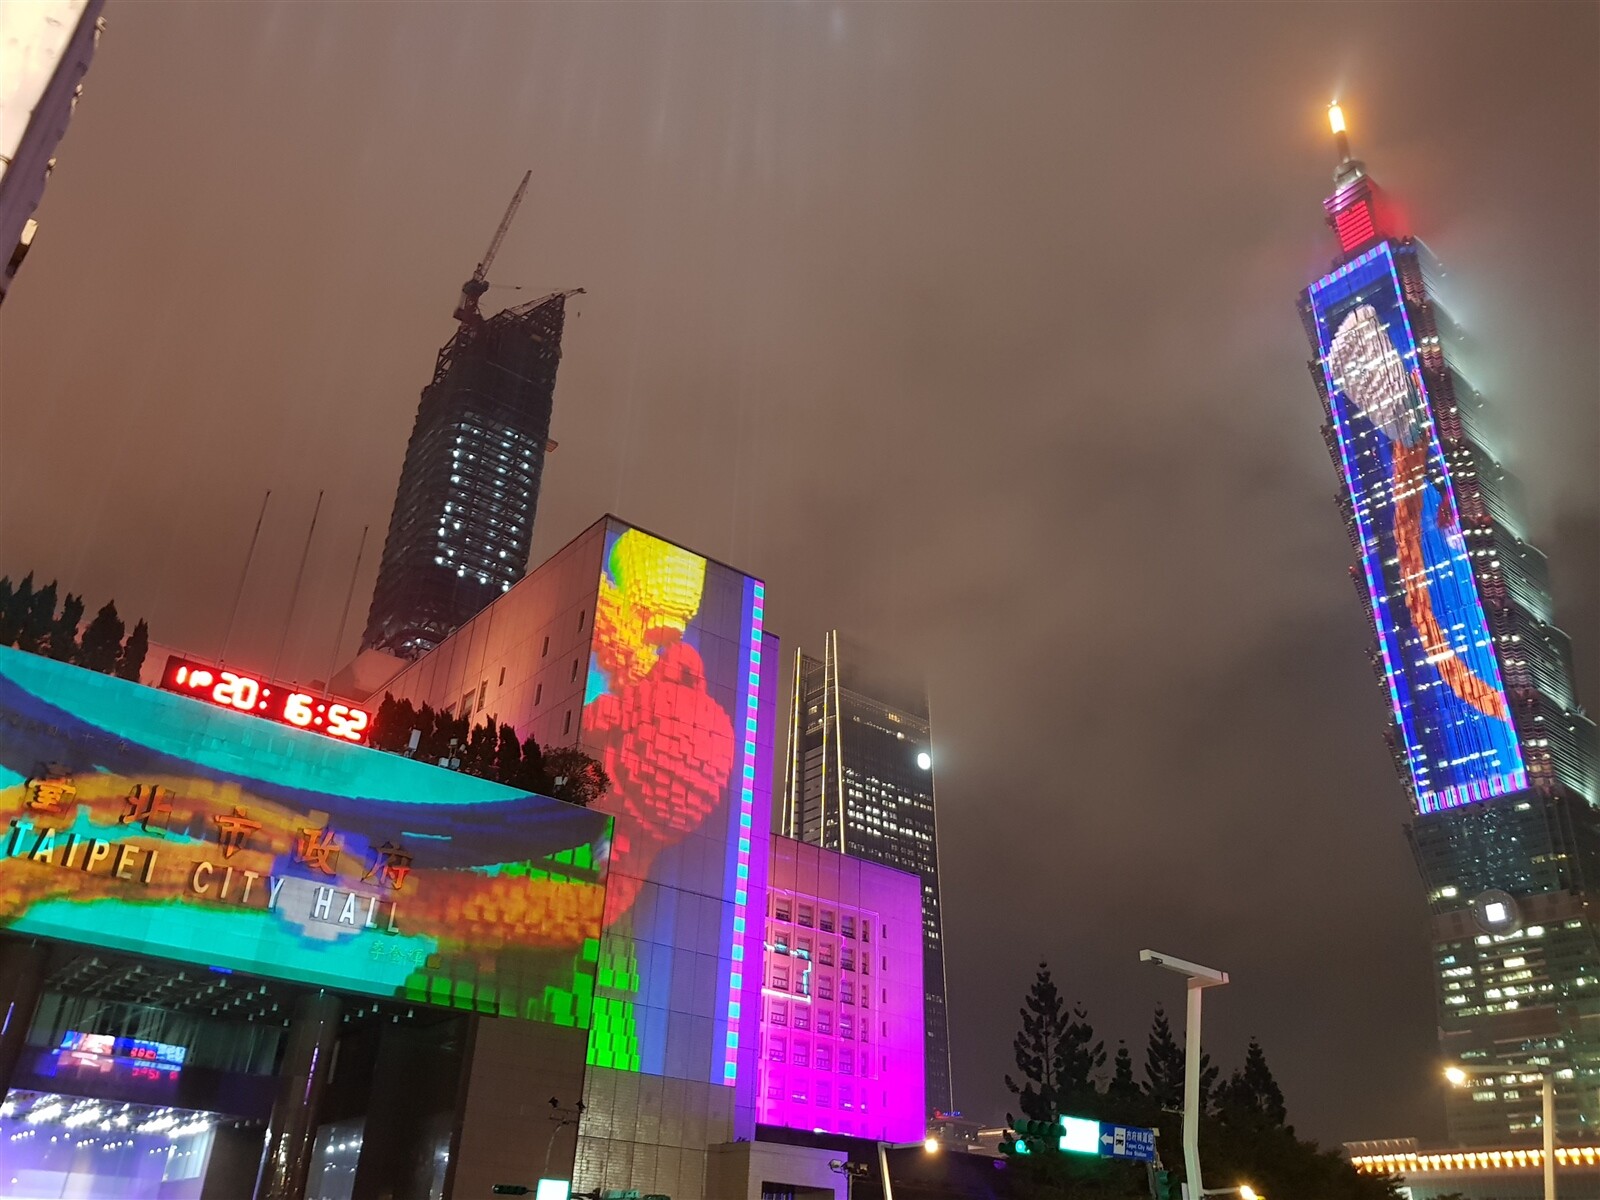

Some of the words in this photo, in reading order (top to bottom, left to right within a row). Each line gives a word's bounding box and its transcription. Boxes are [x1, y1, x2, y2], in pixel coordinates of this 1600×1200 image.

[11, 820, 159, 884] TAIPEI
[192, 861, 286, 910] CITY
[312, 886, 400, 934] HALL
[24, 762, 413, 890] 臺北市政府
